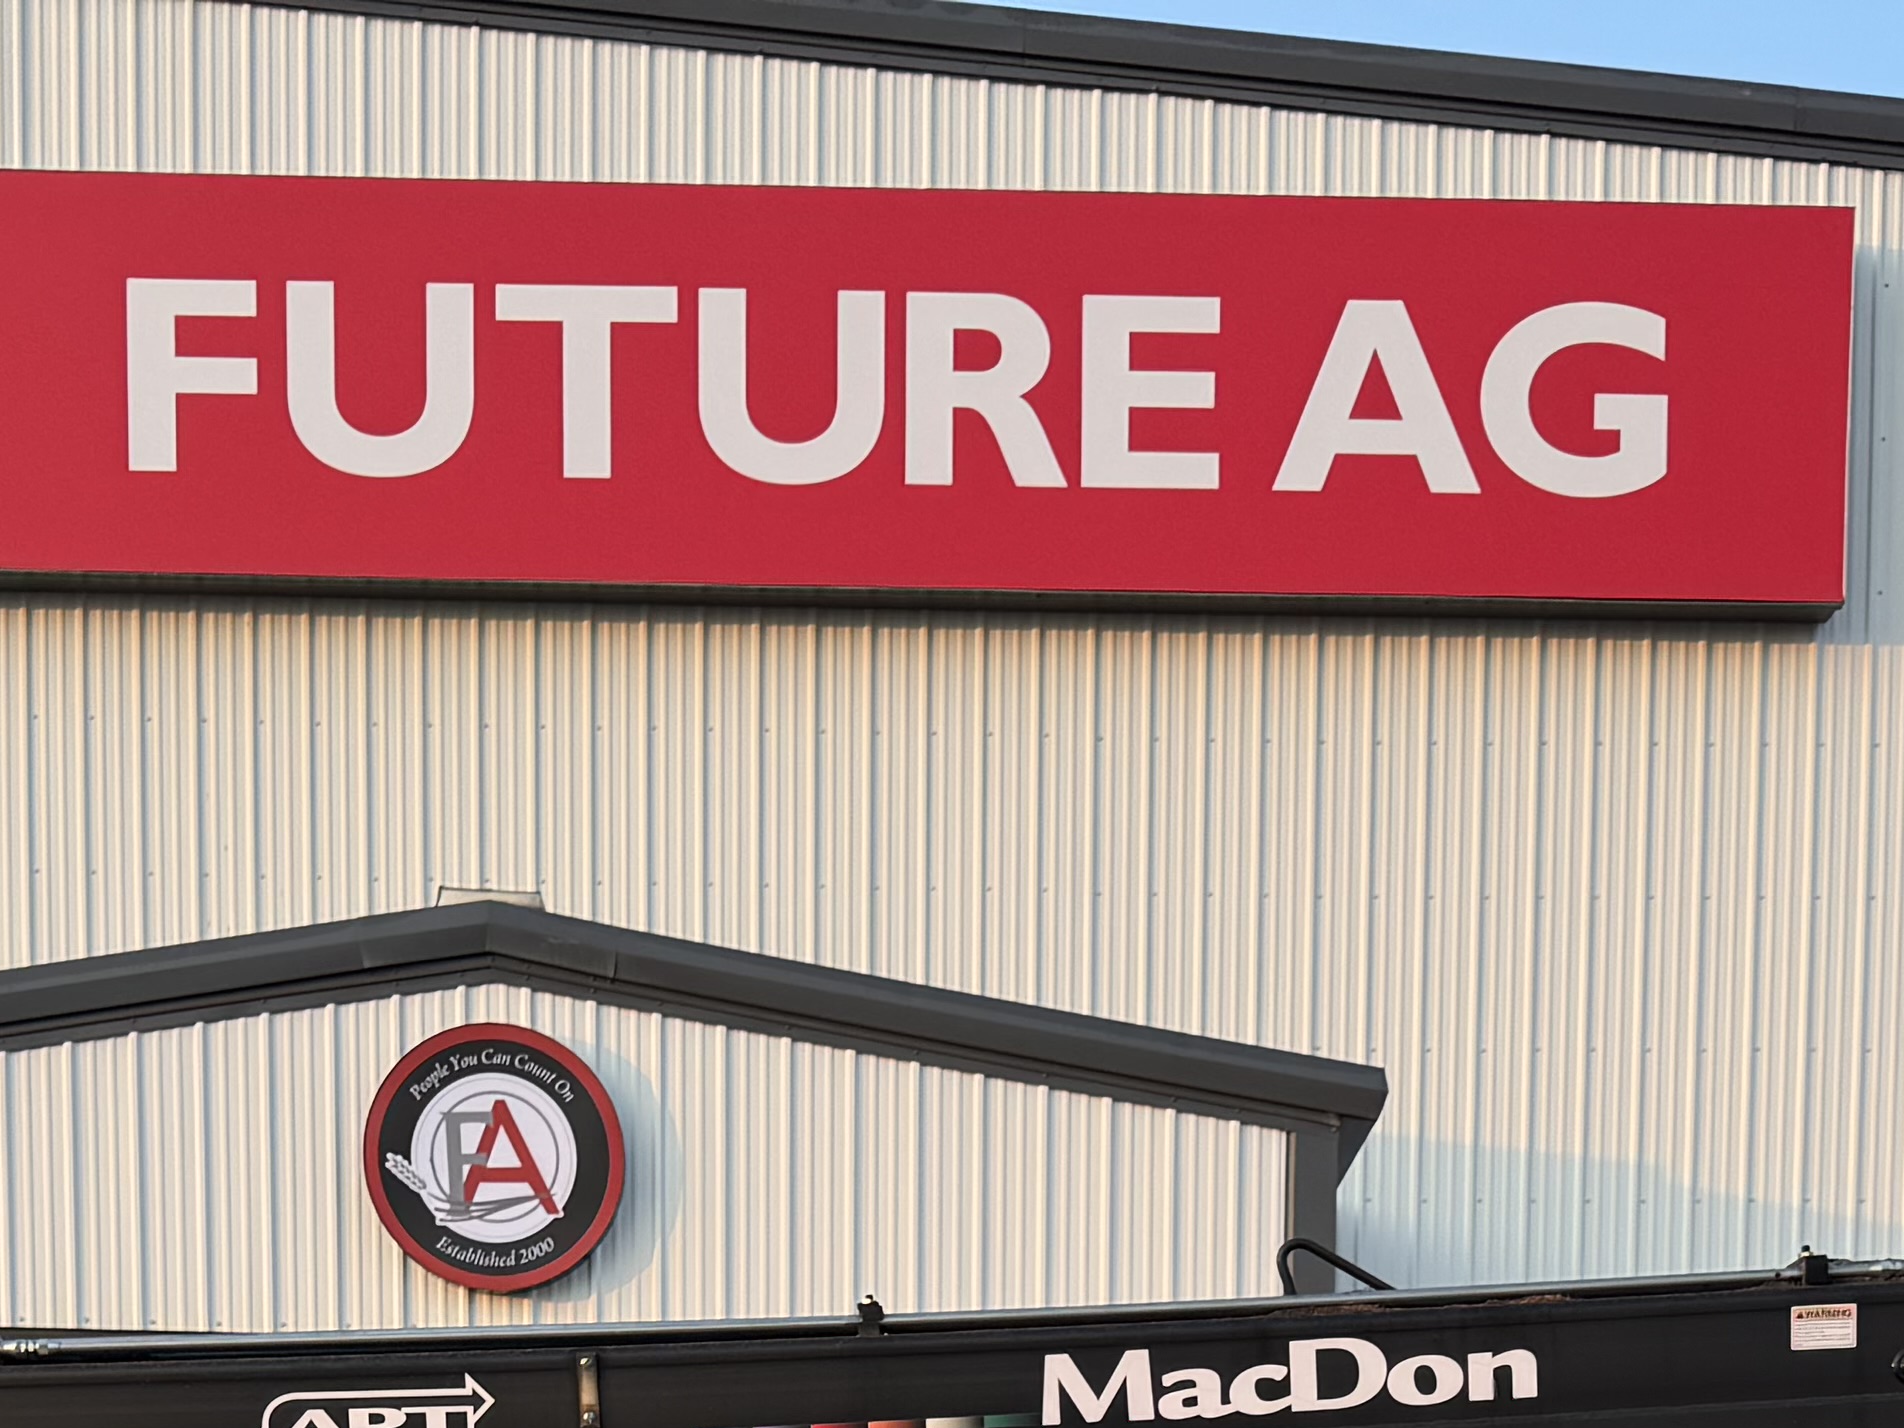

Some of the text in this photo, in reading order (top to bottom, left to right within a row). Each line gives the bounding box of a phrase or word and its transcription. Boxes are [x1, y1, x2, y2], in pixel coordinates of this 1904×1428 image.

[125, 276, 1670, 500] FUTURE AG
[409, 1049, 575, 1102] People You Can Count On
[436, 1236, 555, 1268] Established 2000
[1042, 1336, 1538, 1426] MacDon
